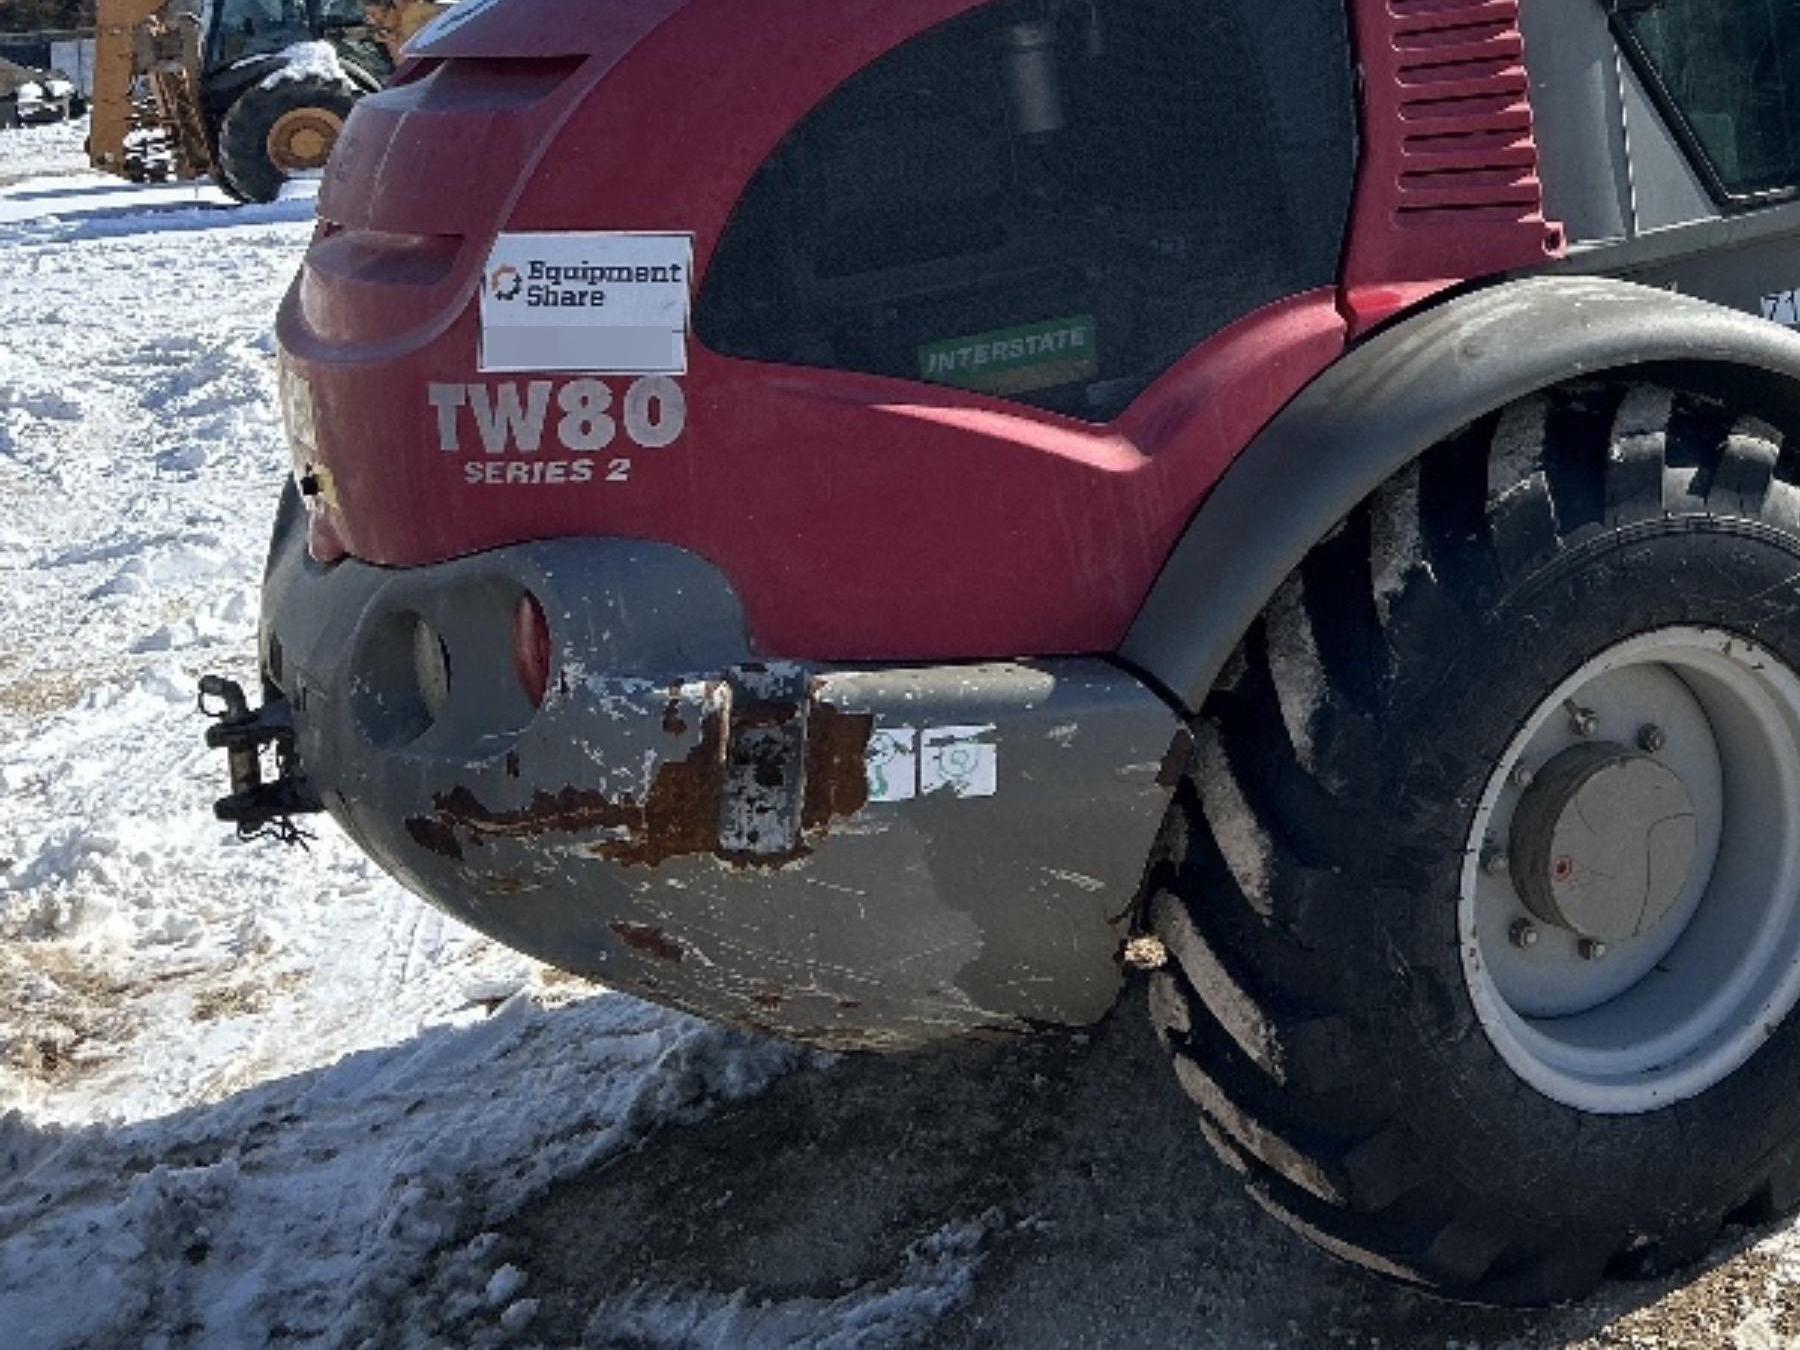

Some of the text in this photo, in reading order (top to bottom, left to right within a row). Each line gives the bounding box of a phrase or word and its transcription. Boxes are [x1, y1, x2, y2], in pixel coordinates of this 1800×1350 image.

[528, 260, 681, 285] Equipment
[527, 285, 604, 307] Share
[928, 326, 1085, 372] INTERSTATE
[428, 375, 687, 454] TW80
[464, 458, 631, 484] SERIES 2
